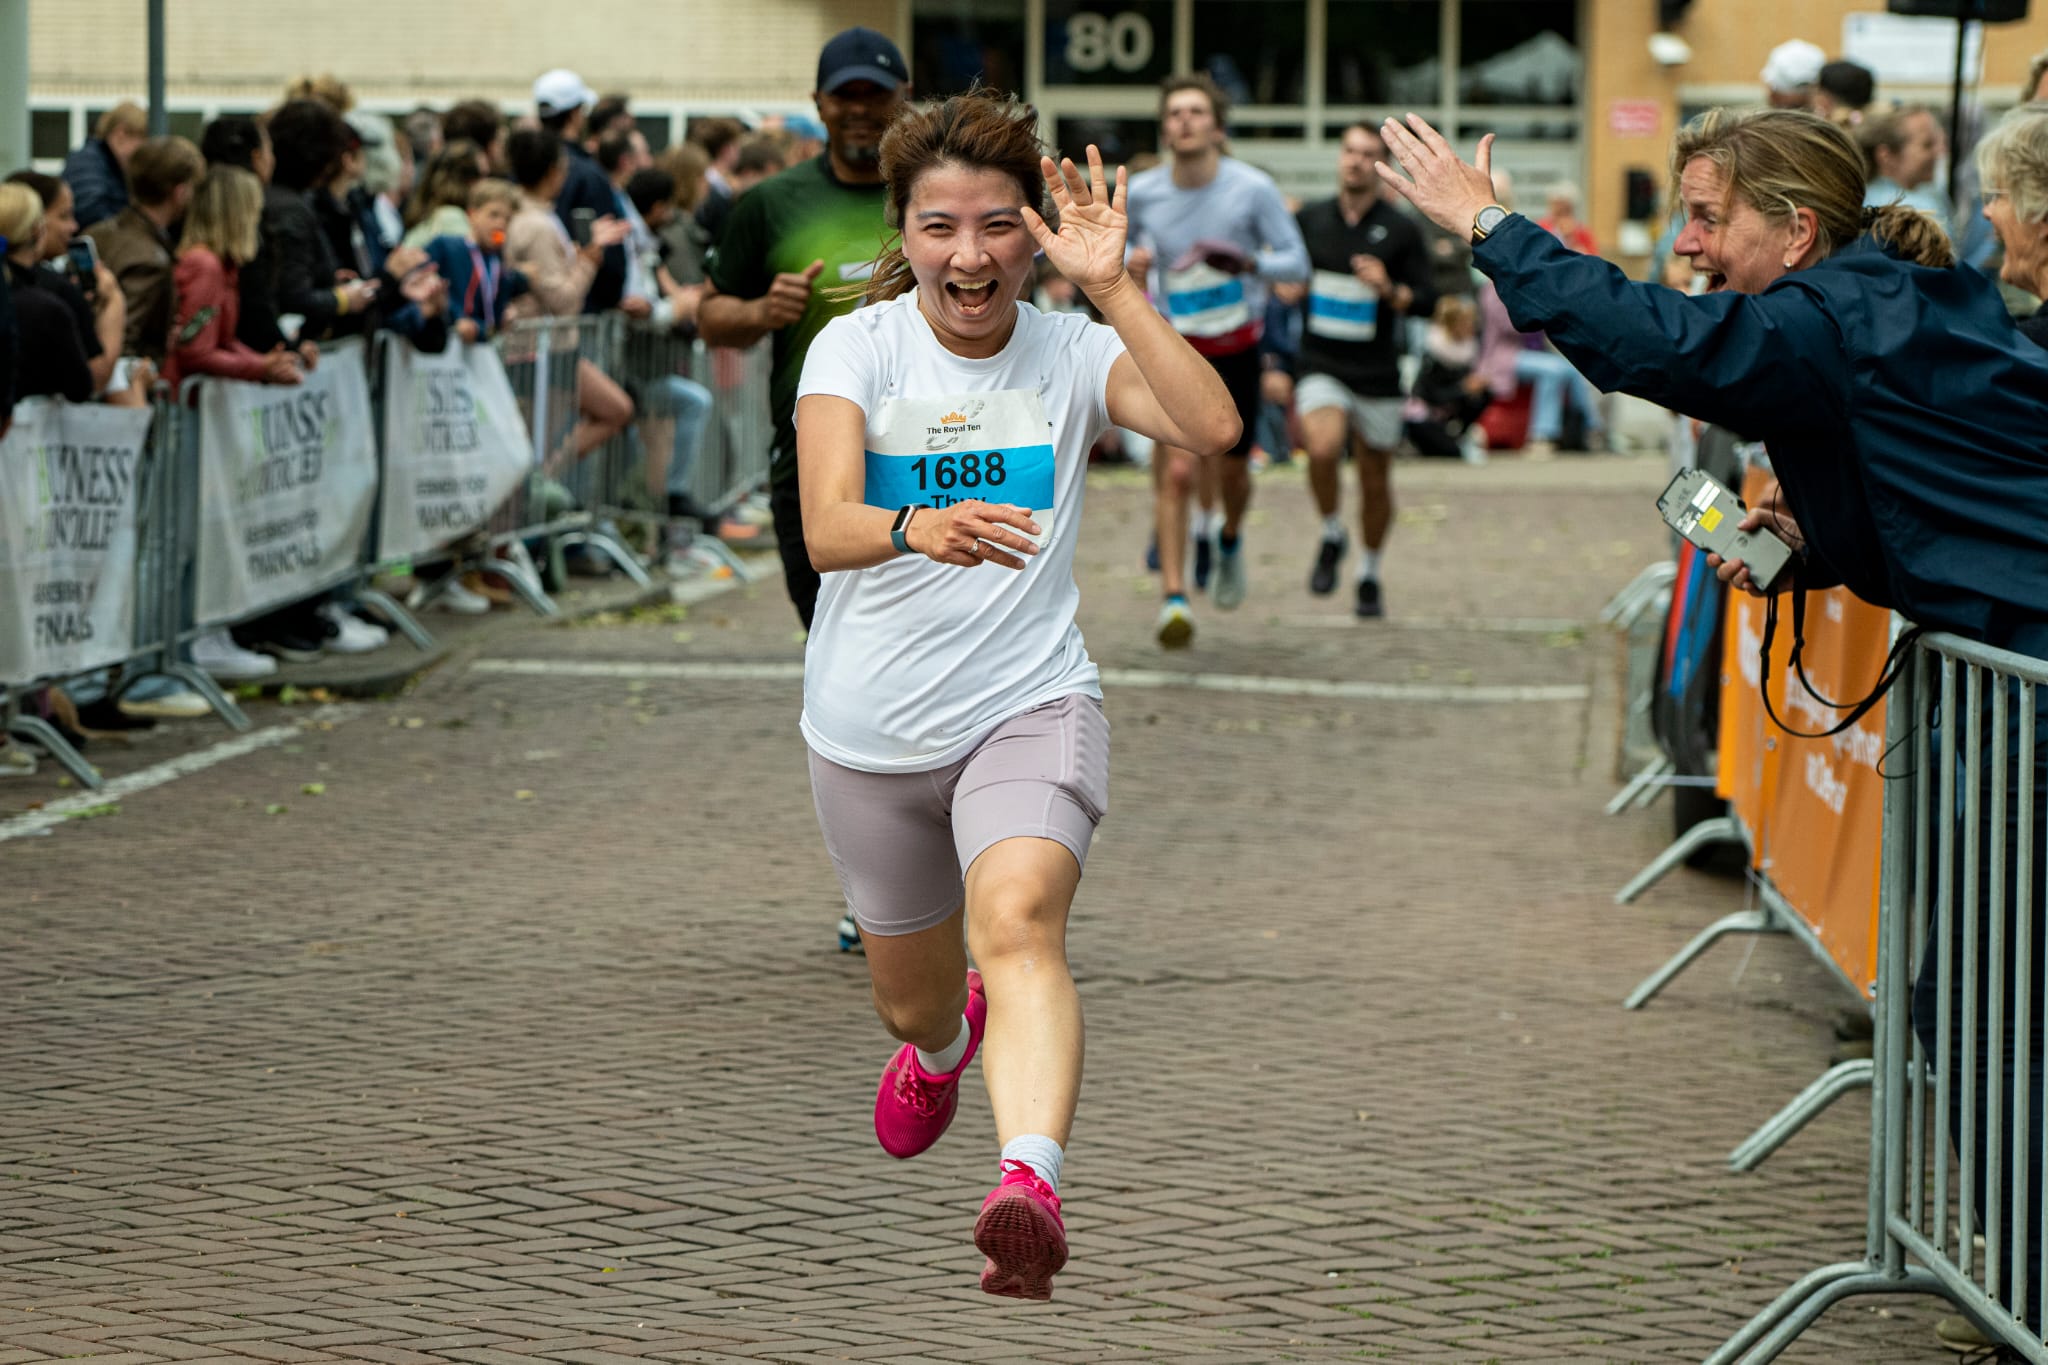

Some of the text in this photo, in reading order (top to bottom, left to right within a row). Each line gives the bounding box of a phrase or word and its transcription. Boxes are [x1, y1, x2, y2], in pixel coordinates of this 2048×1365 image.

[1065, 12, 1153, 71] 80
[926, 424, 981, 435] The Royal Ten
[911, 451, 1007, 491] 1688
